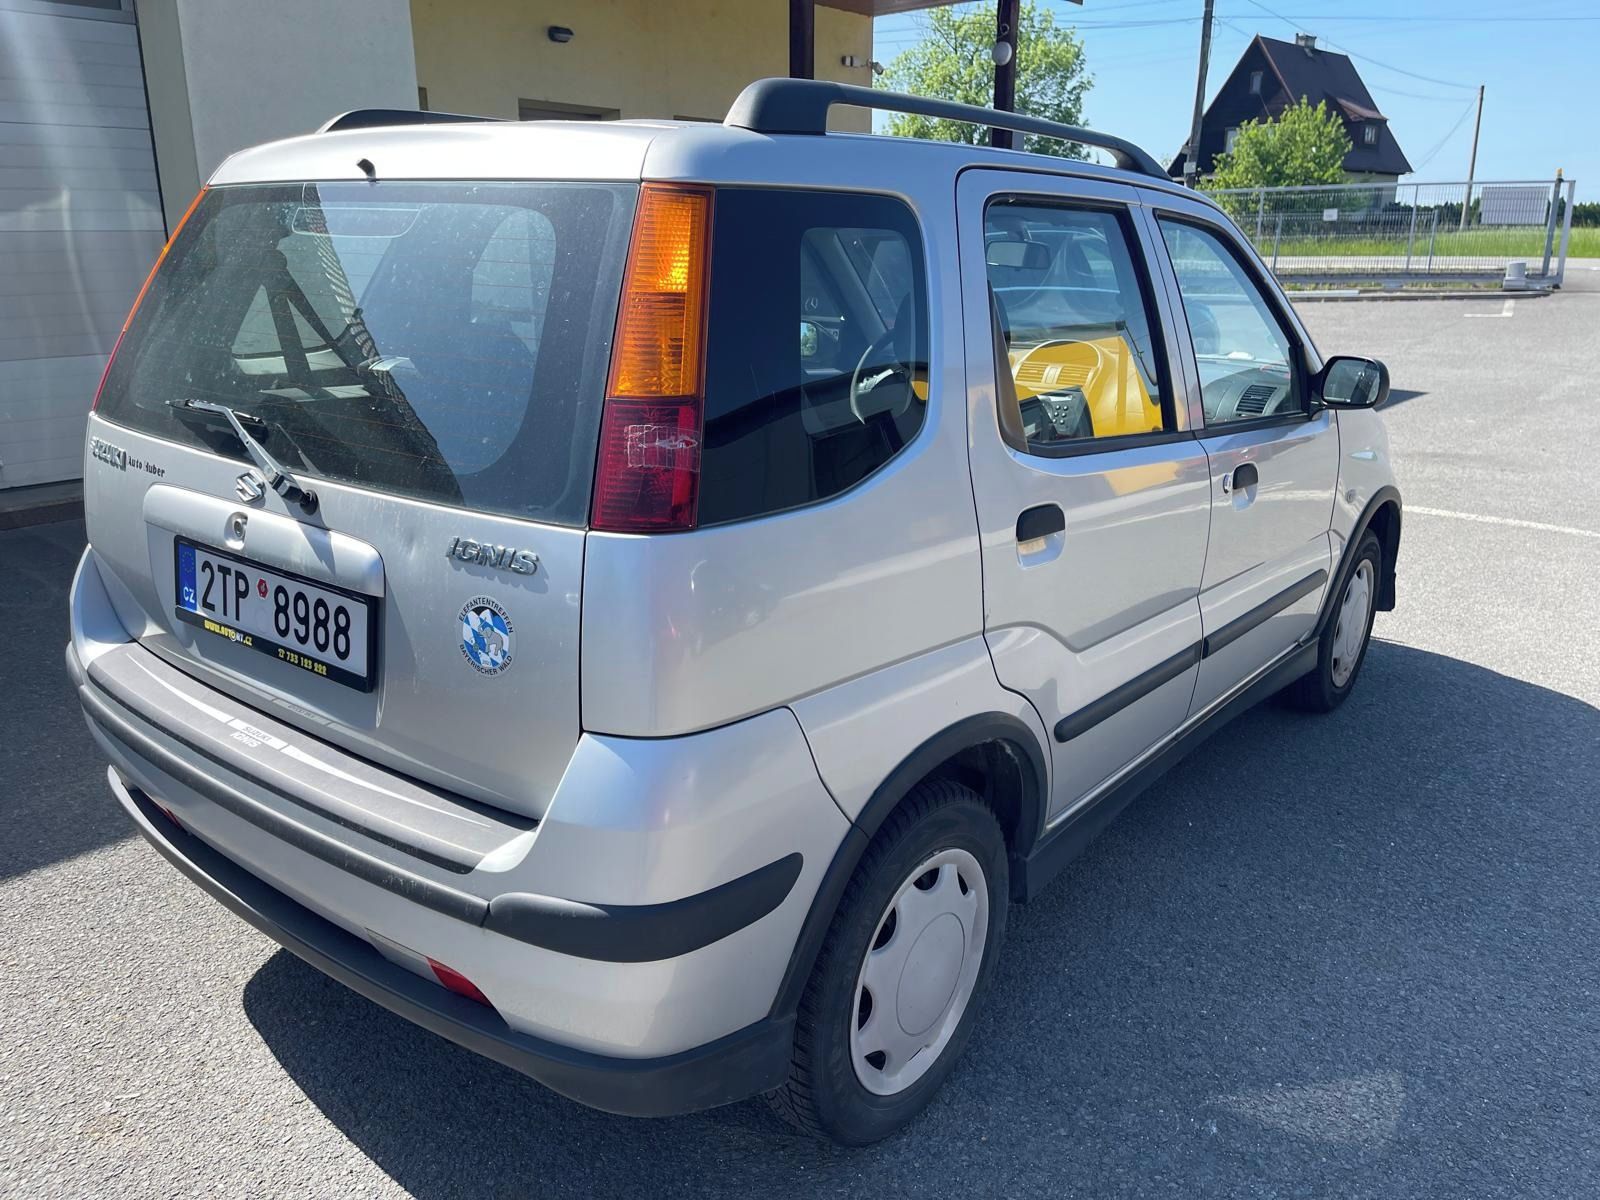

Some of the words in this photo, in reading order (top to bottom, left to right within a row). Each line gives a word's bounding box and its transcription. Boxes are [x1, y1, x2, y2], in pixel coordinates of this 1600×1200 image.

[446, 536, 540, 575] IGNIS
[183, 586, 196, 604] CZ
[201, 560, 250, 621] 2TP
[273, 585, 351, 661] 8988
[458, 597, 514, 633] ELEFANTENTREFFEN
[459, 643, 498, 676] BAYERISCHER
[500, 655, 513, 672] WALD
